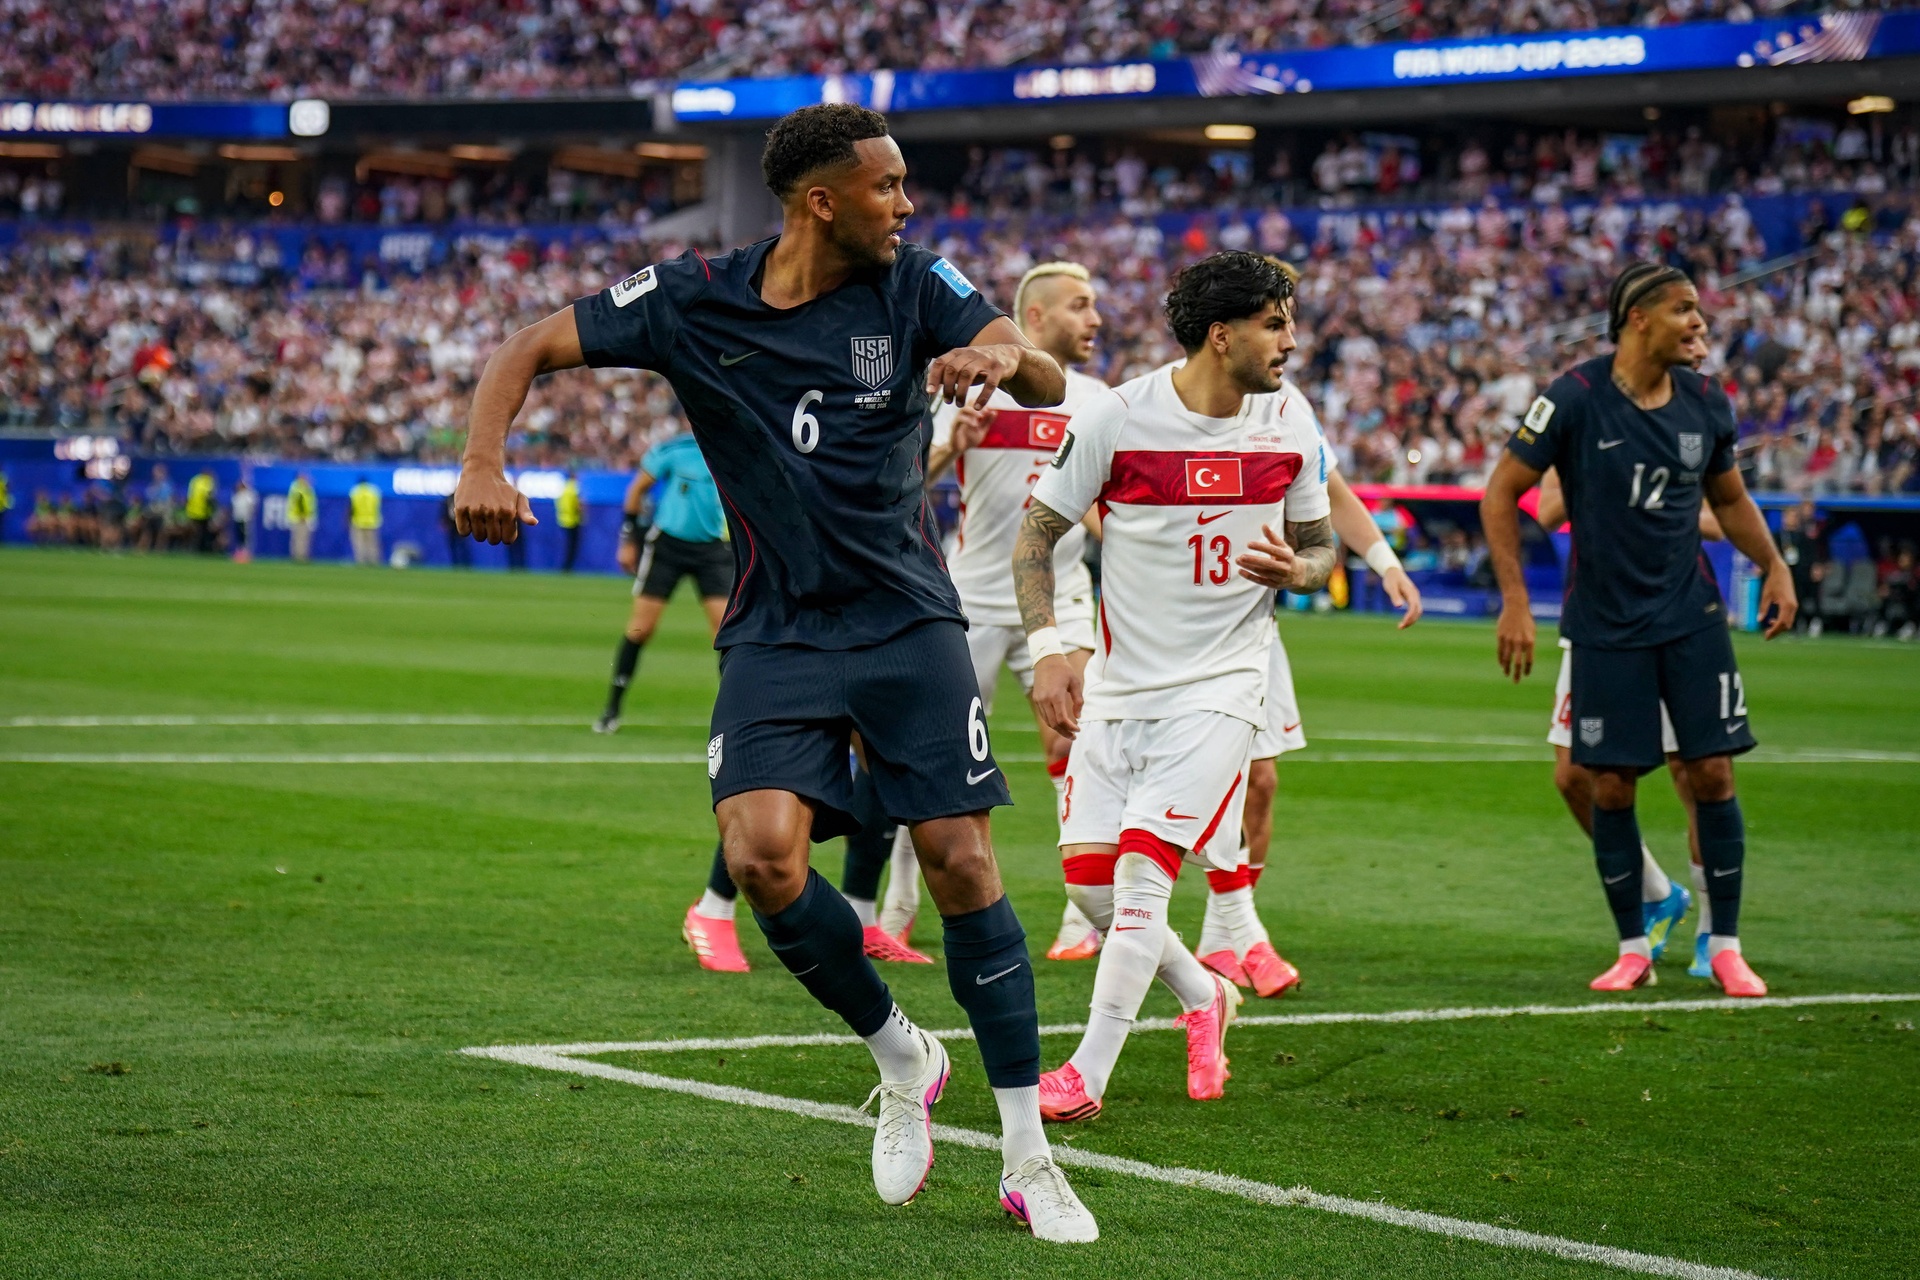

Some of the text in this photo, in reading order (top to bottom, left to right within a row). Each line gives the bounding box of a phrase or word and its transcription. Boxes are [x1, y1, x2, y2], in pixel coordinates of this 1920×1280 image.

[1441, 43, 1519, 76] WORLD
[1520, 40, 1563, 72] CUP
[855, 339, 888, 359] USA
[792, 389, 824, 454] 6
[1627, 462, 1671, 510] 12
[1187, 534, 1232, 587] 13
[1718, 671, 1748, 720] 12
[968, 696, 989, 762] 6
